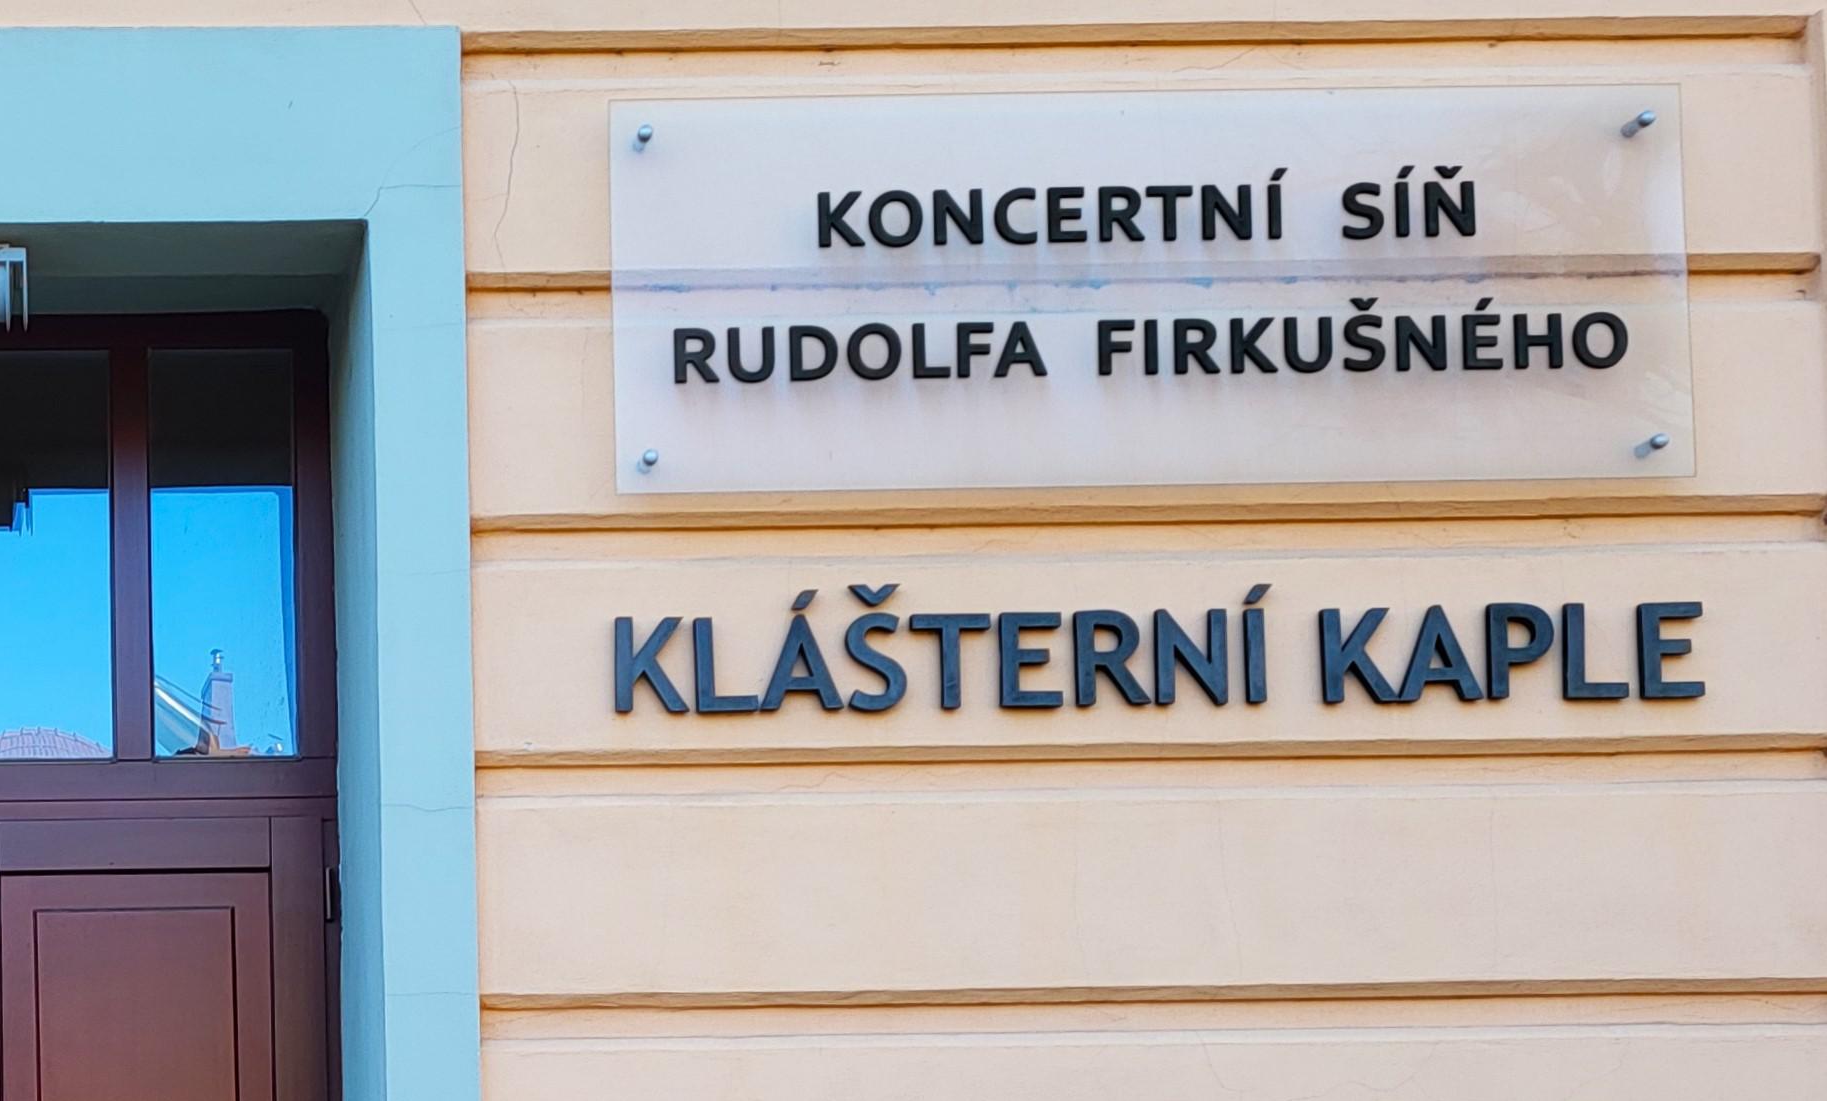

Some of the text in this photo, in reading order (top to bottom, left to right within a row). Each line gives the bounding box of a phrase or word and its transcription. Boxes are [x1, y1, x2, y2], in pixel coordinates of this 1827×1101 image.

[816, 165, 1478, 249] KONCERTNÍ SÍŇ
[672, 297, 1630, 385] RUDOLFA FIRKUŠNÉHO
[612, 583, 1706, 715] KLÁŠTERNÍ KAPLE
